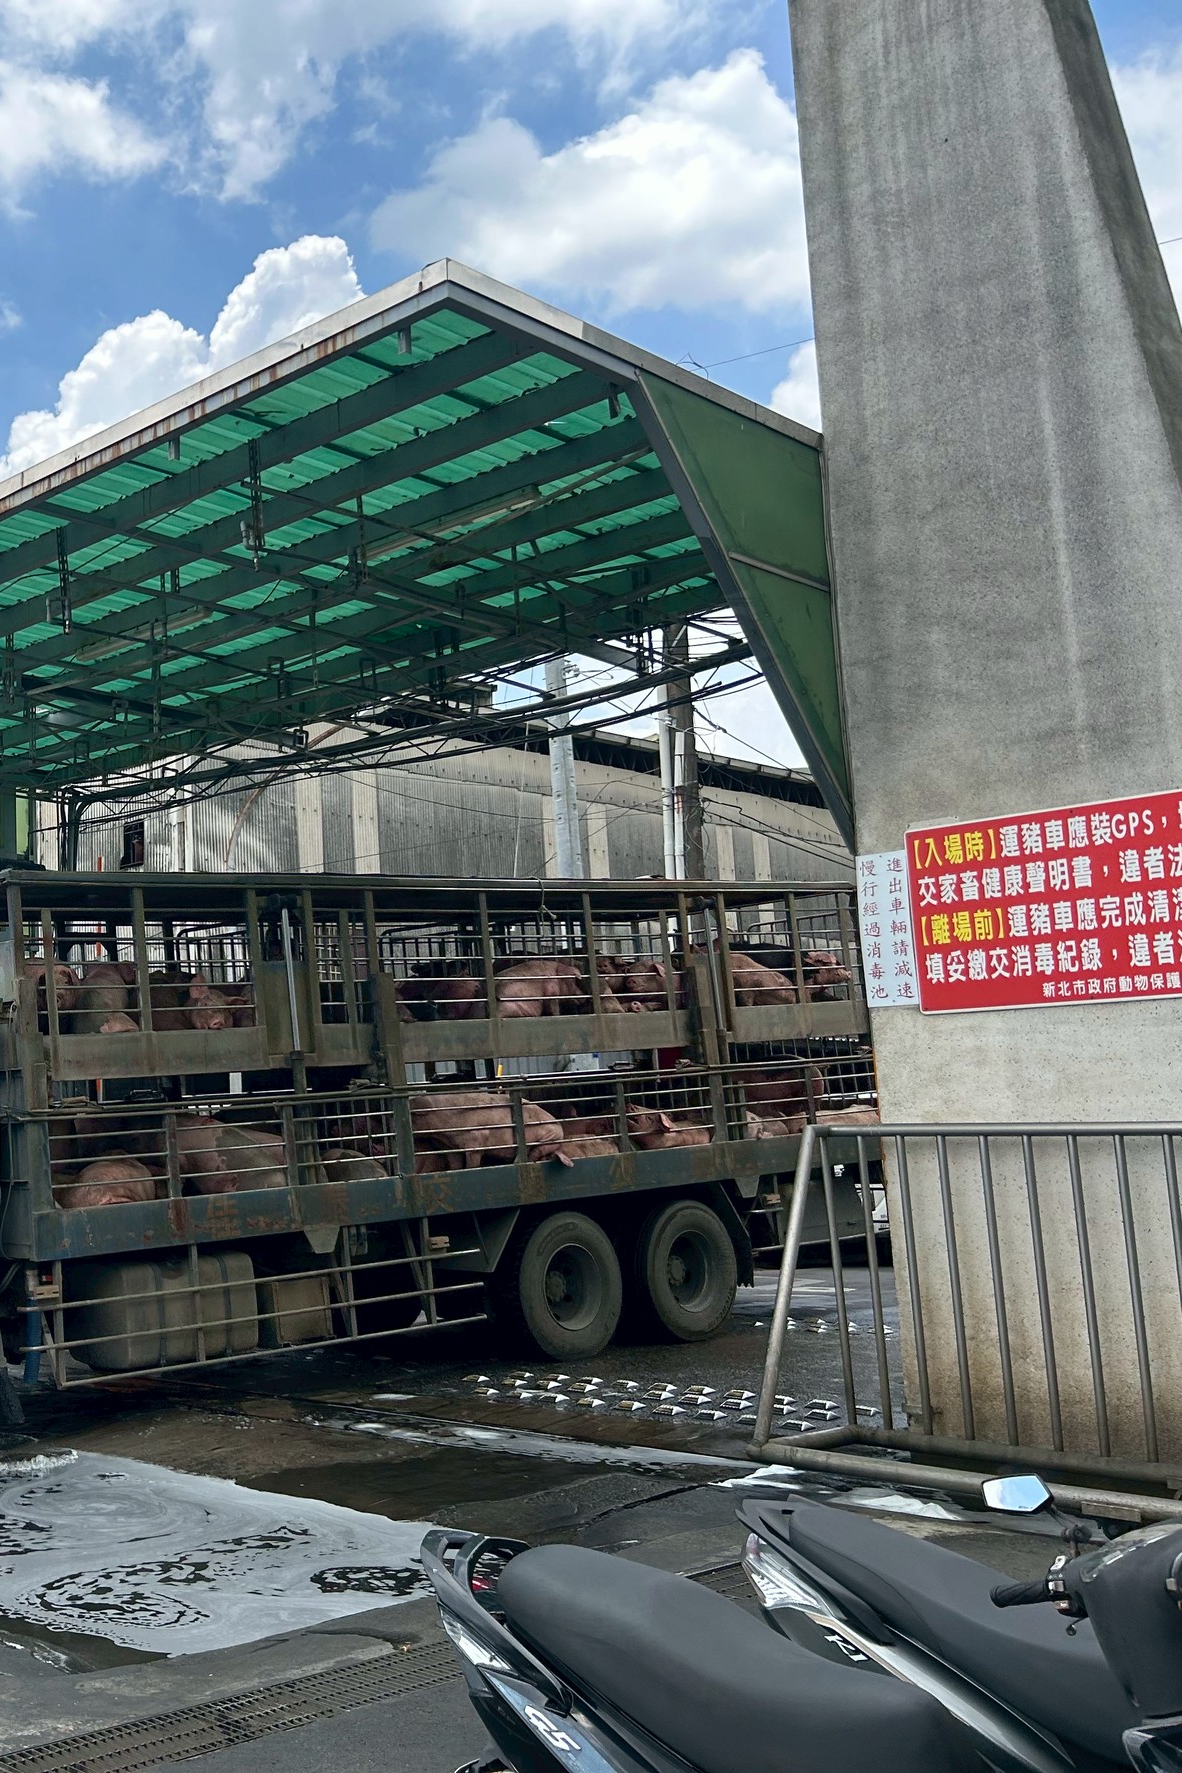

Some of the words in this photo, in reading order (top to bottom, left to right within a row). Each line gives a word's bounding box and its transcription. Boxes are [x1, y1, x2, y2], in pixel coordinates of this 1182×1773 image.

[913, 801, 1182, 869] 【入場時】運豬車應裝GPS，
[859, 859, 889, 999] 慢行經過消毒池
[886, 857, 915, 999] 進出車輛請減速
[925, 929, 1182, 984] 填妥繳交消毒紀錄，違者
[1042, 971, 1182, 998] 新北市政府動物保護
